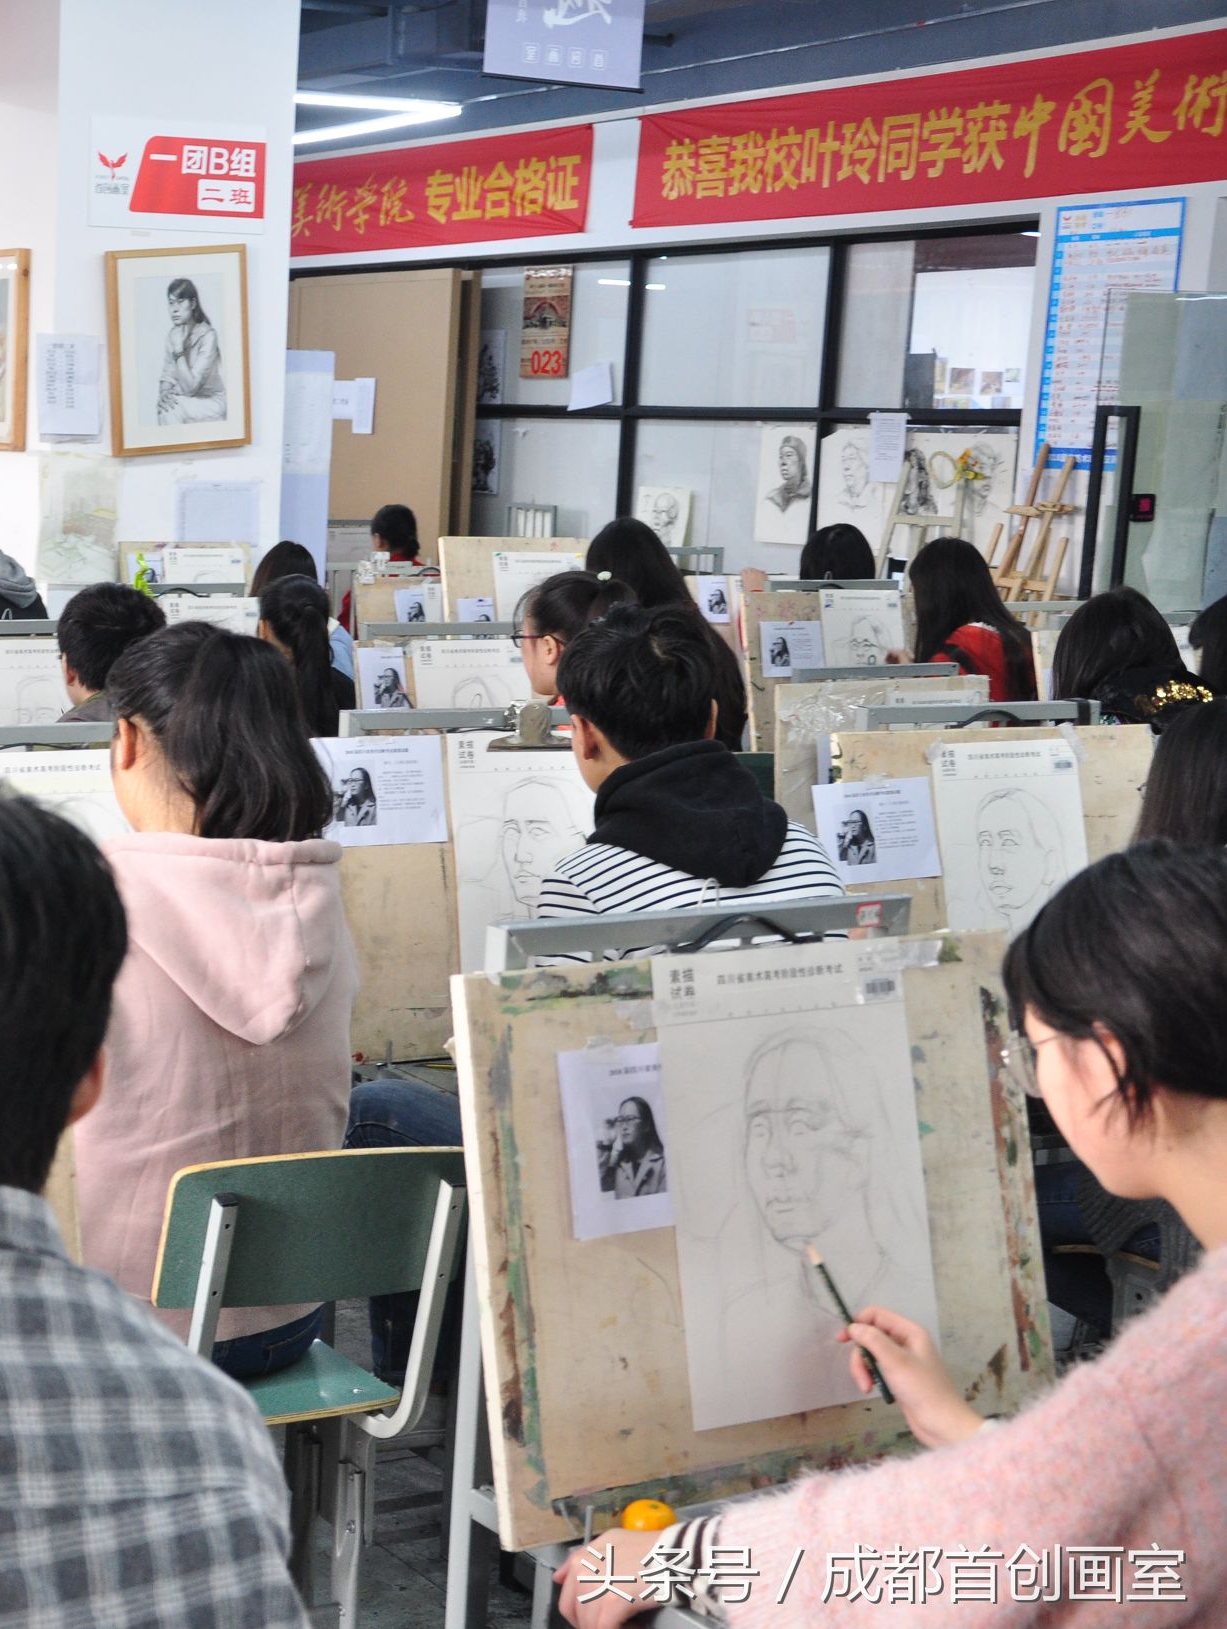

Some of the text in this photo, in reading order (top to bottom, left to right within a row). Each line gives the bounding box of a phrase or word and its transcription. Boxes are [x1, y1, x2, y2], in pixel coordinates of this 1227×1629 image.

[149, 145, 257, 177] 一团B组
[202, 188, 252, 205] 二班
[425, 155, 582, 224] 专业合格证
[531, 351, 562, 374] 023
